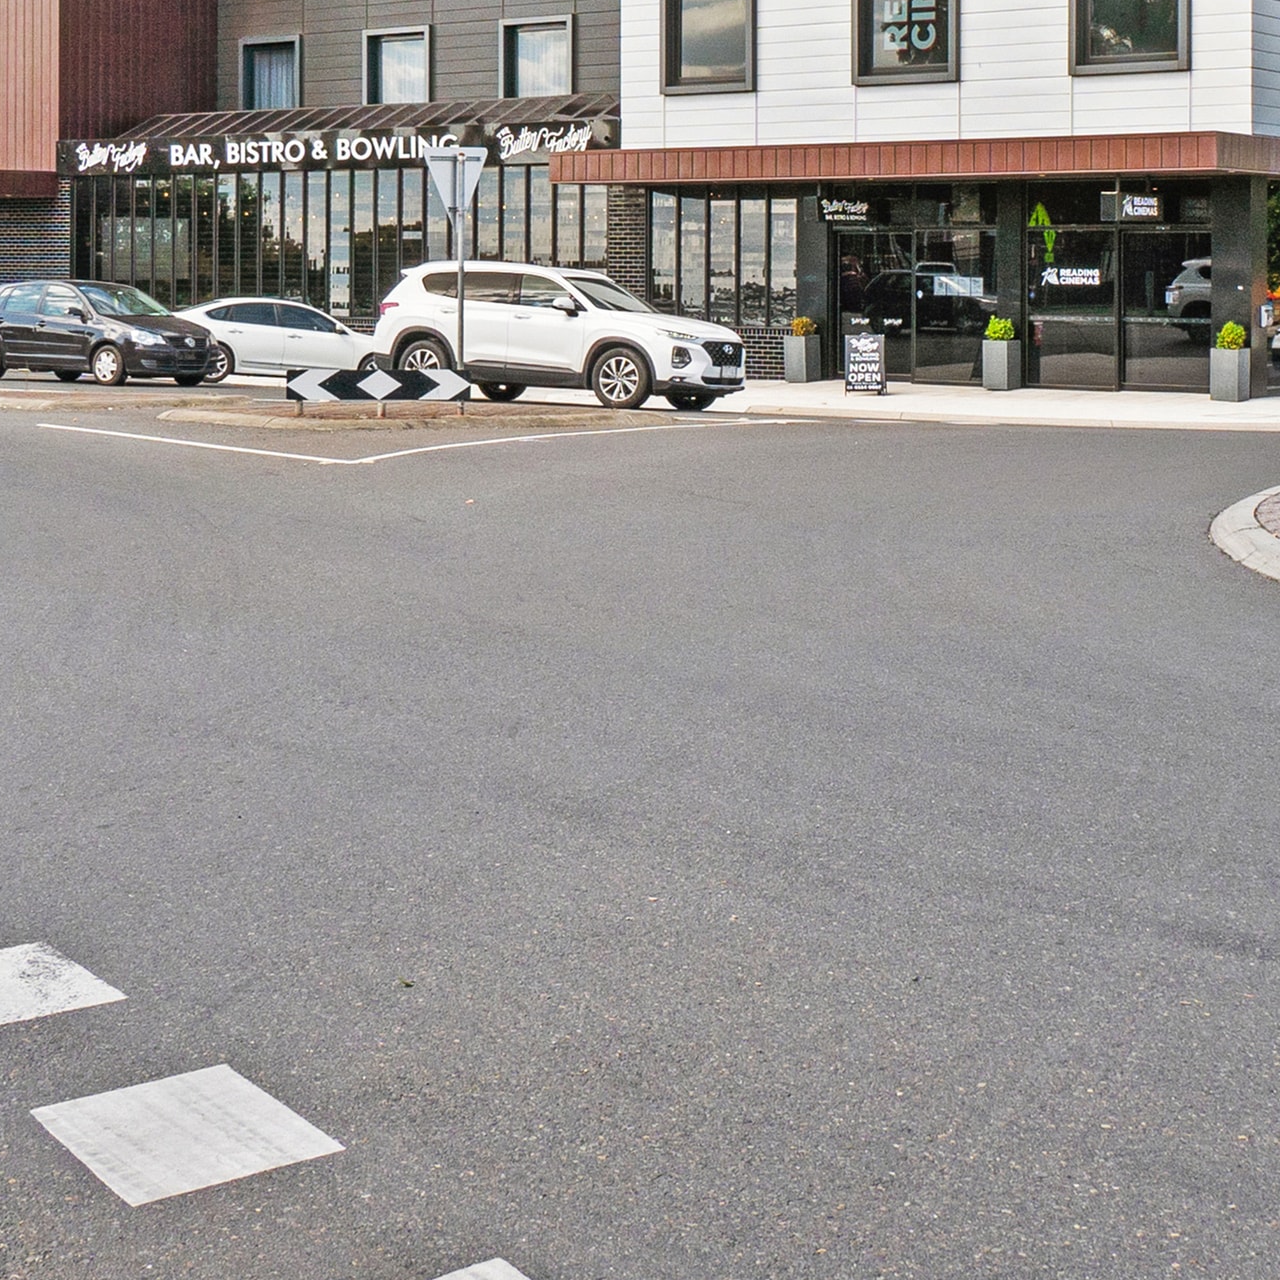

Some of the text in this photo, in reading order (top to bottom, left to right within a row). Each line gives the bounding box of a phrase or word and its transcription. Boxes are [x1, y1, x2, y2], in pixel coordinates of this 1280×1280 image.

[499, 126, 548, 160] Butter
[544, 123, 593, 153] Factory
[170, 143, 221, 170] BAR,
[226, 140, 306, 165] BISTRO
[311, 138, 329, 161] &
[1133, 197, 1158, 206] READING
[1133, 206, 1158, 216] CINEMAS
[1060, 268, 1099, 277] READING
[1060, 276, 1100, 285] CINEMAS
[849, 363, 880, 372] NOW
[848, 372, 881, 382] OPEN
